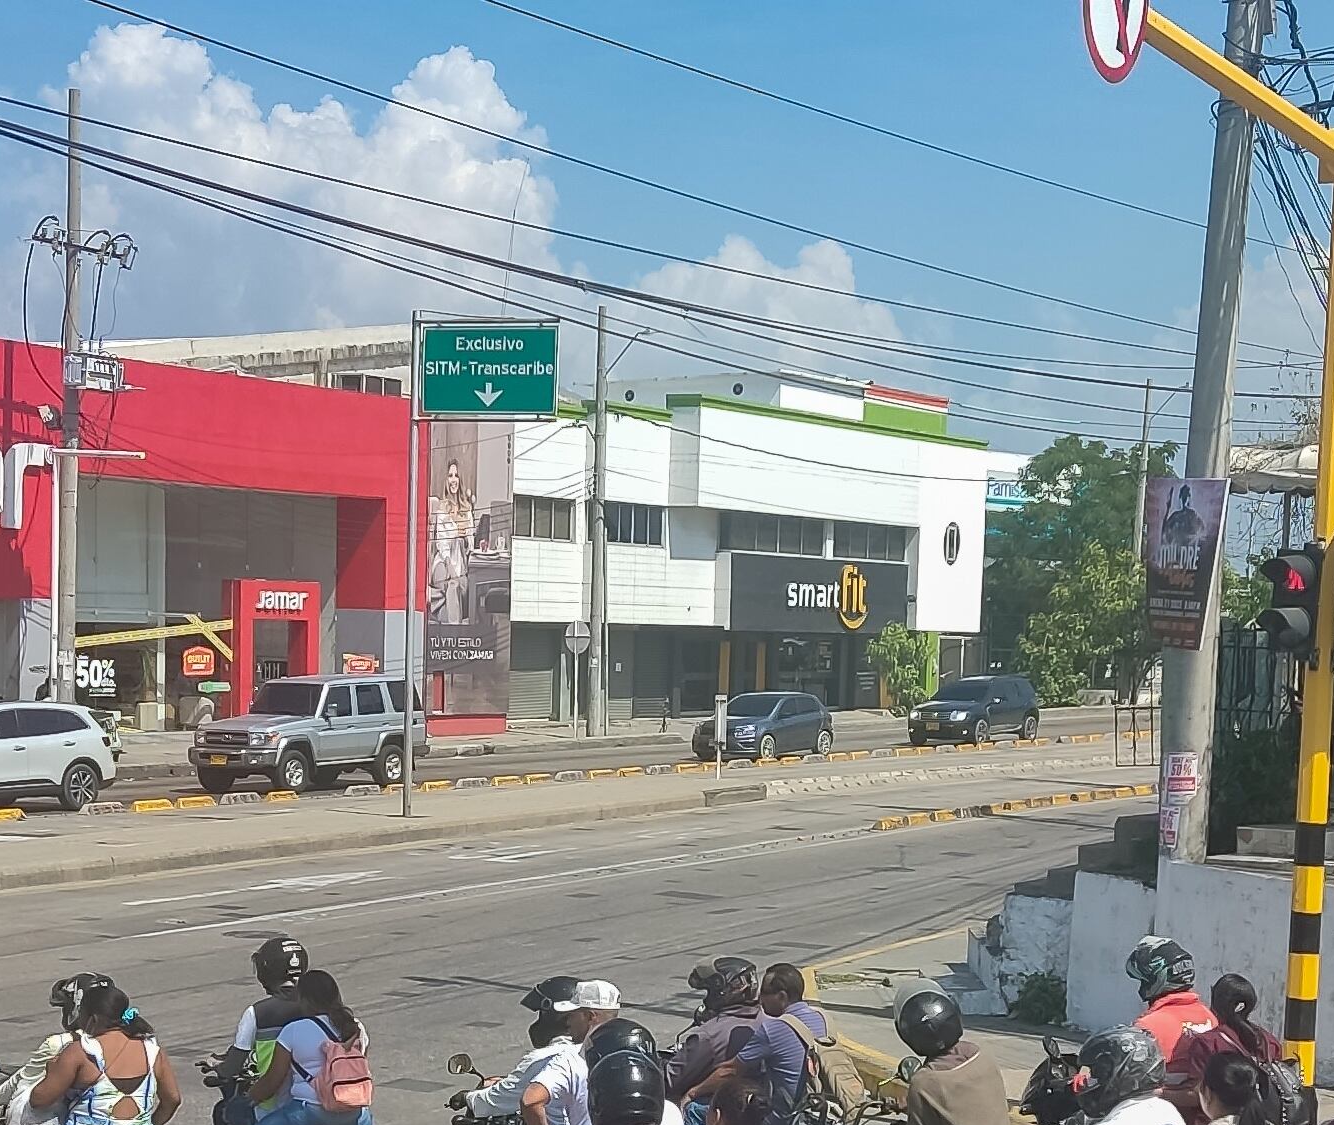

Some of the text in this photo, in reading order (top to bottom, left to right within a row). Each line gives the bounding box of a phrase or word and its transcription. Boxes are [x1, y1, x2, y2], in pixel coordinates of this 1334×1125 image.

[455, 336, 524, 351] Exclusivo
[425, 360, 554, 376] SITM-Transcaribe
[787, 564, 867, 614] smart fit
[76, 660, 115, 688] 50%
